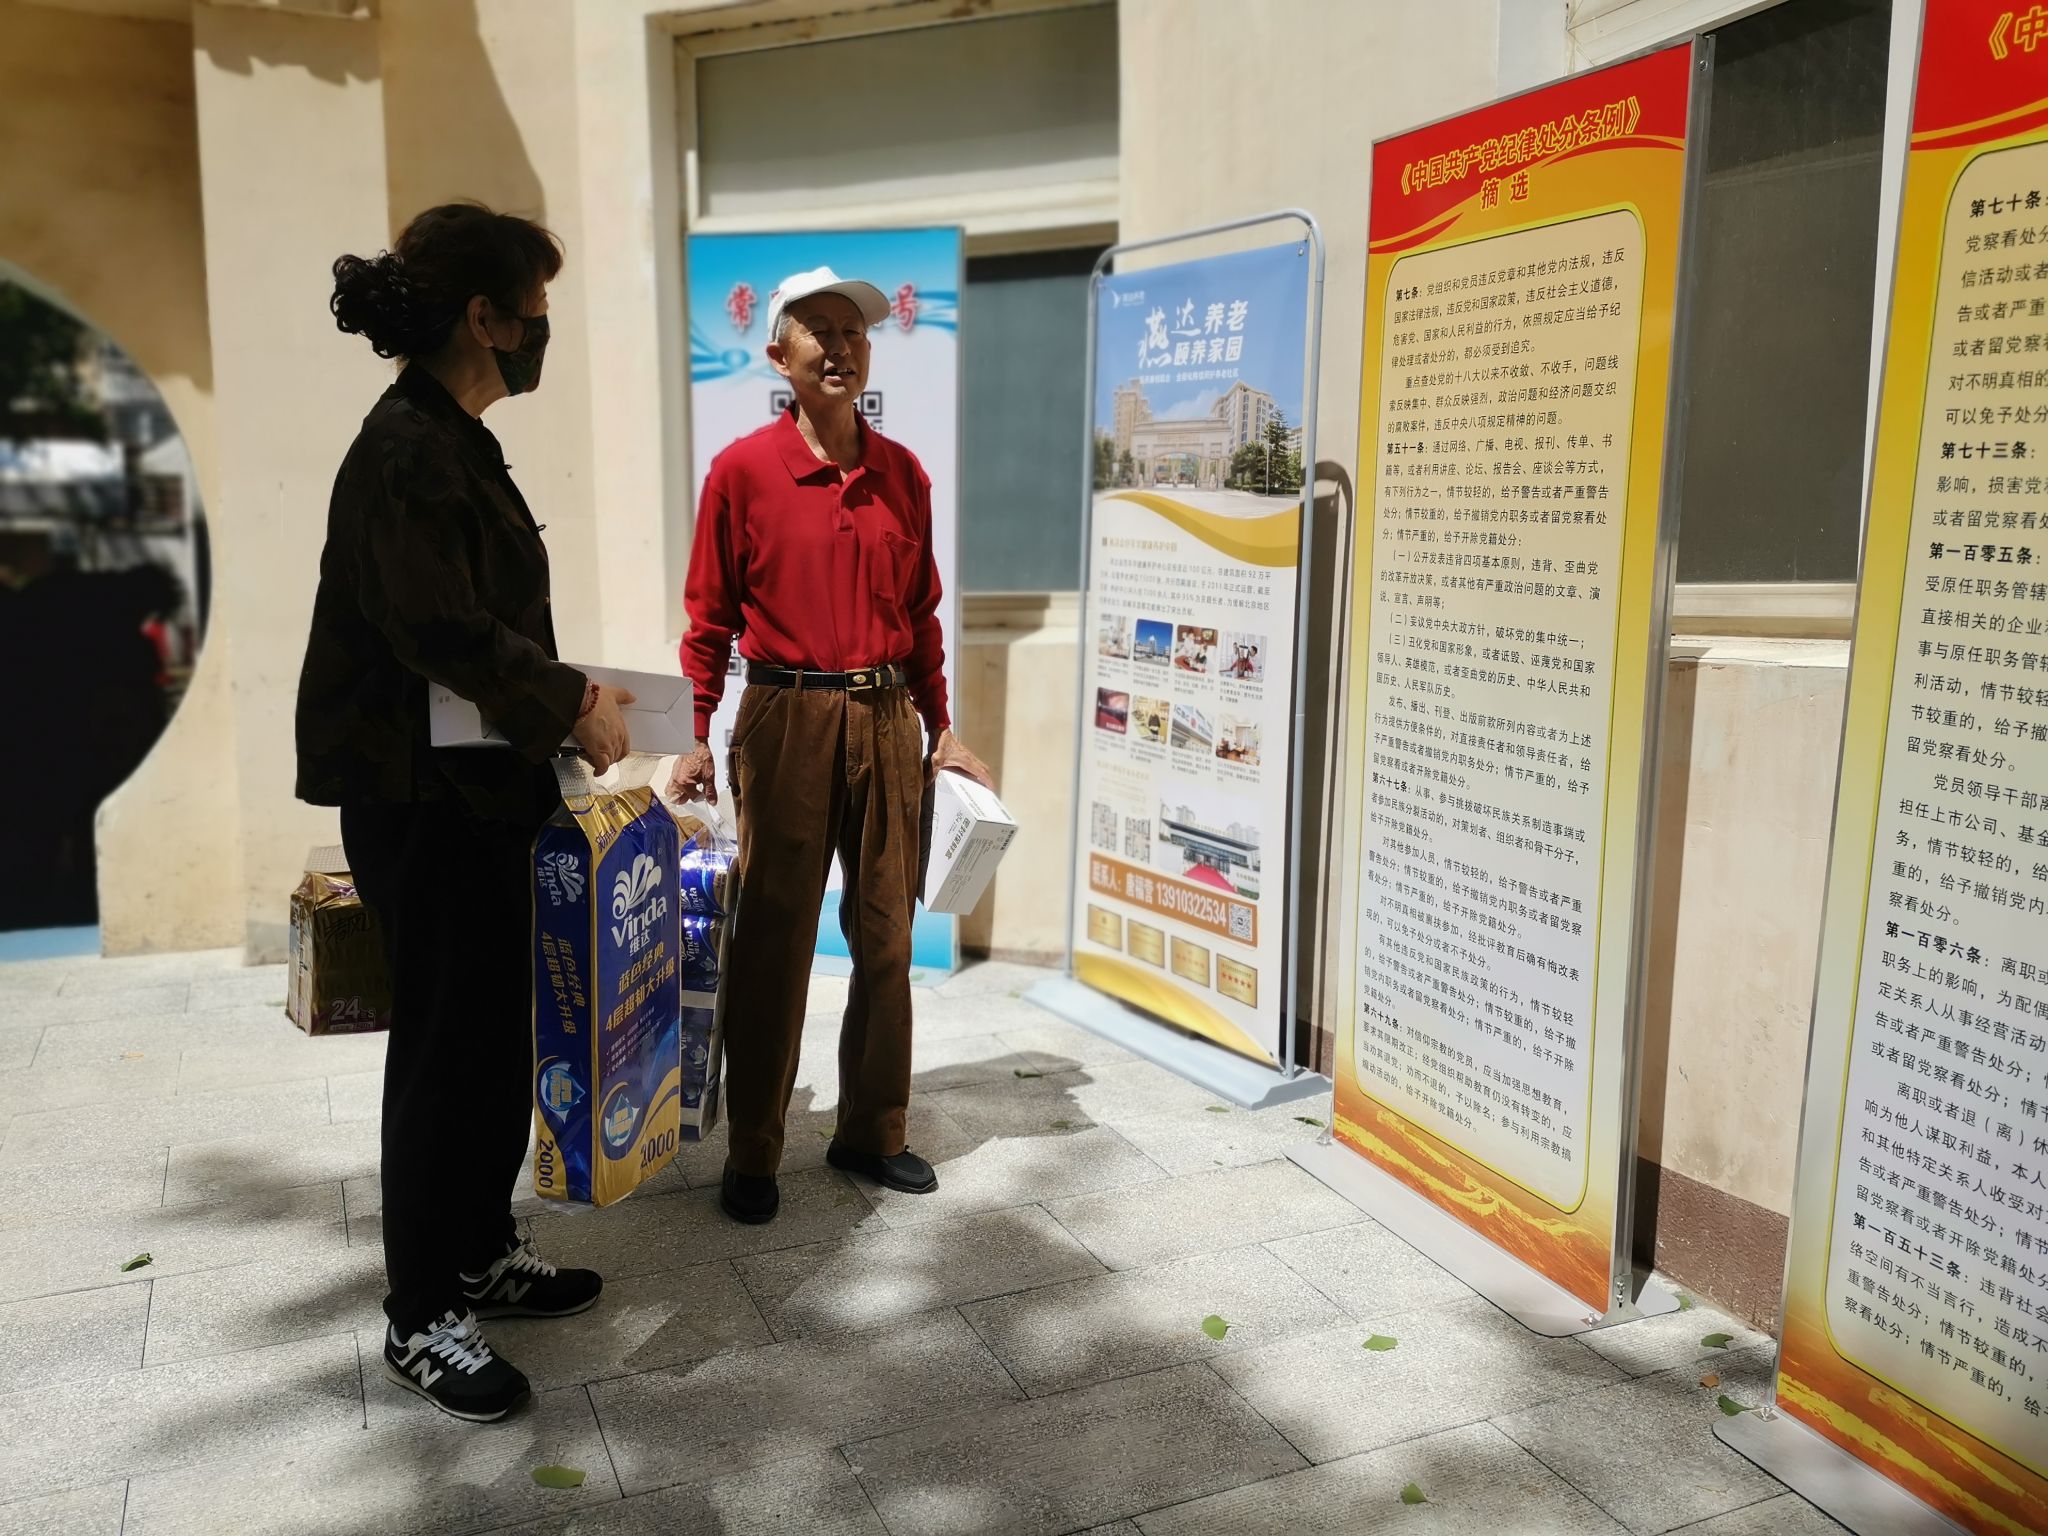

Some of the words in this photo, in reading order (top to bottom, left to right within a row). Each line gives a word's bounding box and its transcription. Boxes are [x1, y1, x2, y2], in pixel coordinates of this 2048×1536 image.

[1988, 6, 2048, 60] 《中
[1400, 96, 1641, 196] 《中国共产党纪律处分条例》
[1393, 302, 1621, 346] 危害党、国家和人民利益的行为，依照规定应当给予纪
[1957, 297, 2046, 324] 告或者严重
[1173, 336, 1244, 366] 颐养家园
[1952, 333, 2048, 357] 或者留党察
[1936, 476, 2048, 495] 影响，损害党
[1921, 608, 2048, 636] 直接相关的企业
[1907, 736, 2015, 772] 留党察看处分。
[542, 850, 562, 907] Vinda
[1891, 860, 2048, 916] 重的，给予撤销党内
[611, 895, 668, 948] Vinda
[1888, 891, 1960, 926] 察看处分。
[618, 941, 665, 995] 蓝色经典
[629, 928, 651, 957] 维达
[605, 956, 676, 1033] 4层超韧大升级
[1875, 1010, 2048, 1089] 告或者严重警告处分；
[538, 1138, 554, 1189] 2000
[1861, 1127, 2048, 1224] 和其他特定关系人收受对
[1847, 1268, 2048, 1389] 重警告处分；情节较重的，
[1845, 1296, 2048, 1418] 察看处分；情节严重的，给
